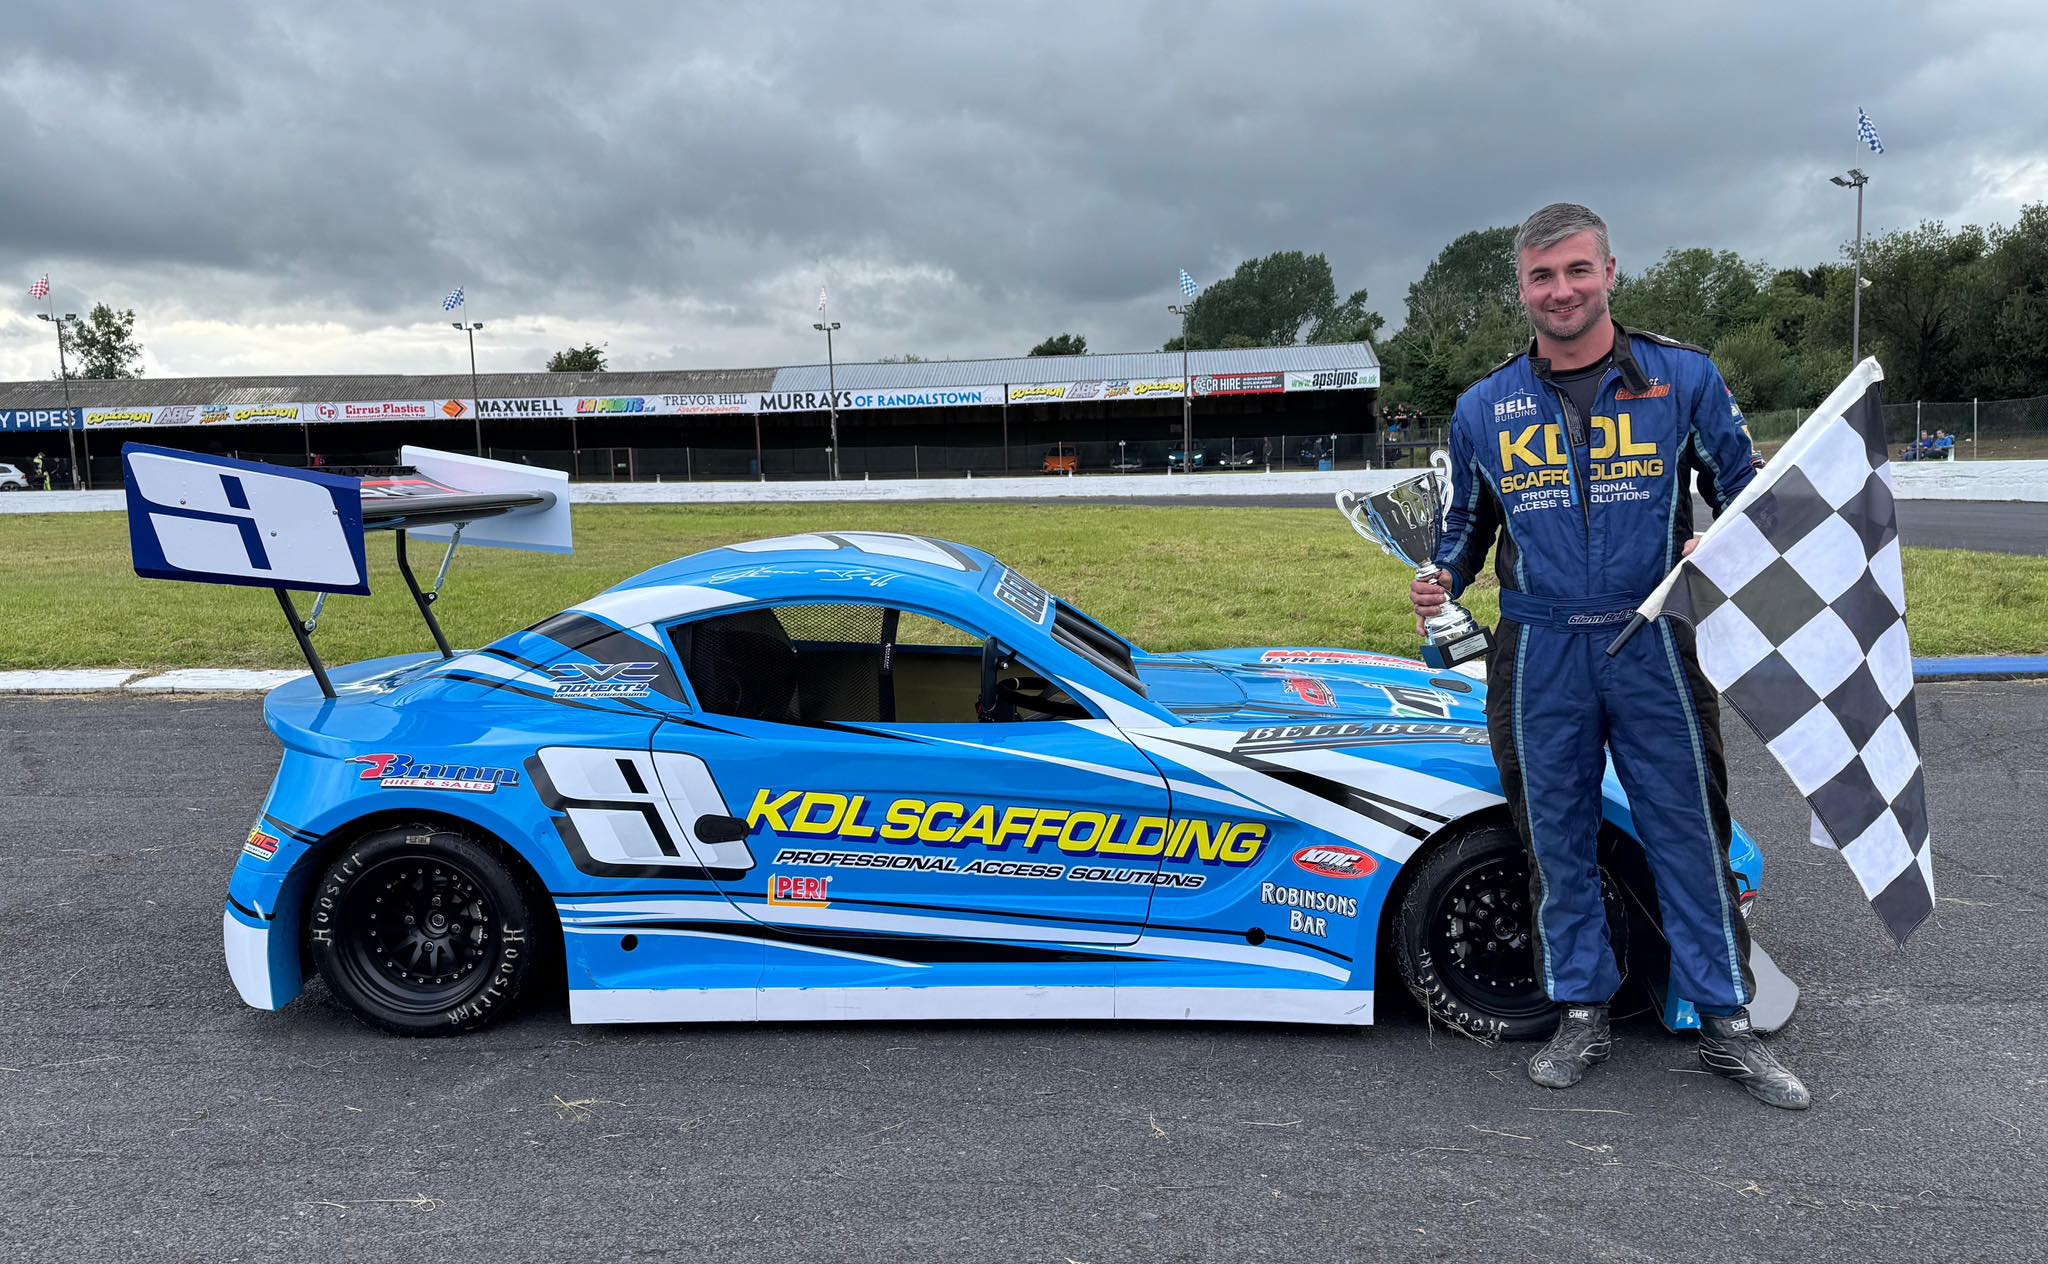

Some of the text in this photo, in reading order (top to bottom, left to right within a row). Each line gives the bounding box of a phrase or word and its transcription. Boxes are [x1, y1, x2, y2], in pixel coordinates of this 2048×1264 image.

[1220, 378, 1241, 391] HIRE
[477, 399, 564, 413] MAXWELL
[663, 394, 747, 406] TREVOR HILL
[759, 391, 851, 410] MURRAYS
[855, 395, 873, 407] OF
[877, 391, 982, 407] RANDALSTOWN
[1494, 396, 1537, 416] BELL
[345, 403, 426, 415] Cirrus Plastics
[1495, 408, 1537, 423] BUILDING
[16, 410, 76, 428] PIPES
[1512, 499, 1557, 515] ACCESS
[555, 683, 650, 694] DOHERTY
[1249, 723, 1364, 740] BELL
[441, 780, 492, 790] SALES
[746, 788, 1268, 863] KDL SCAFFOLDING
[775, 849, 1204, 888] PROFESSIONAL ACCESS SOLUTIONS
[777, 876, 828, 900] PERI
